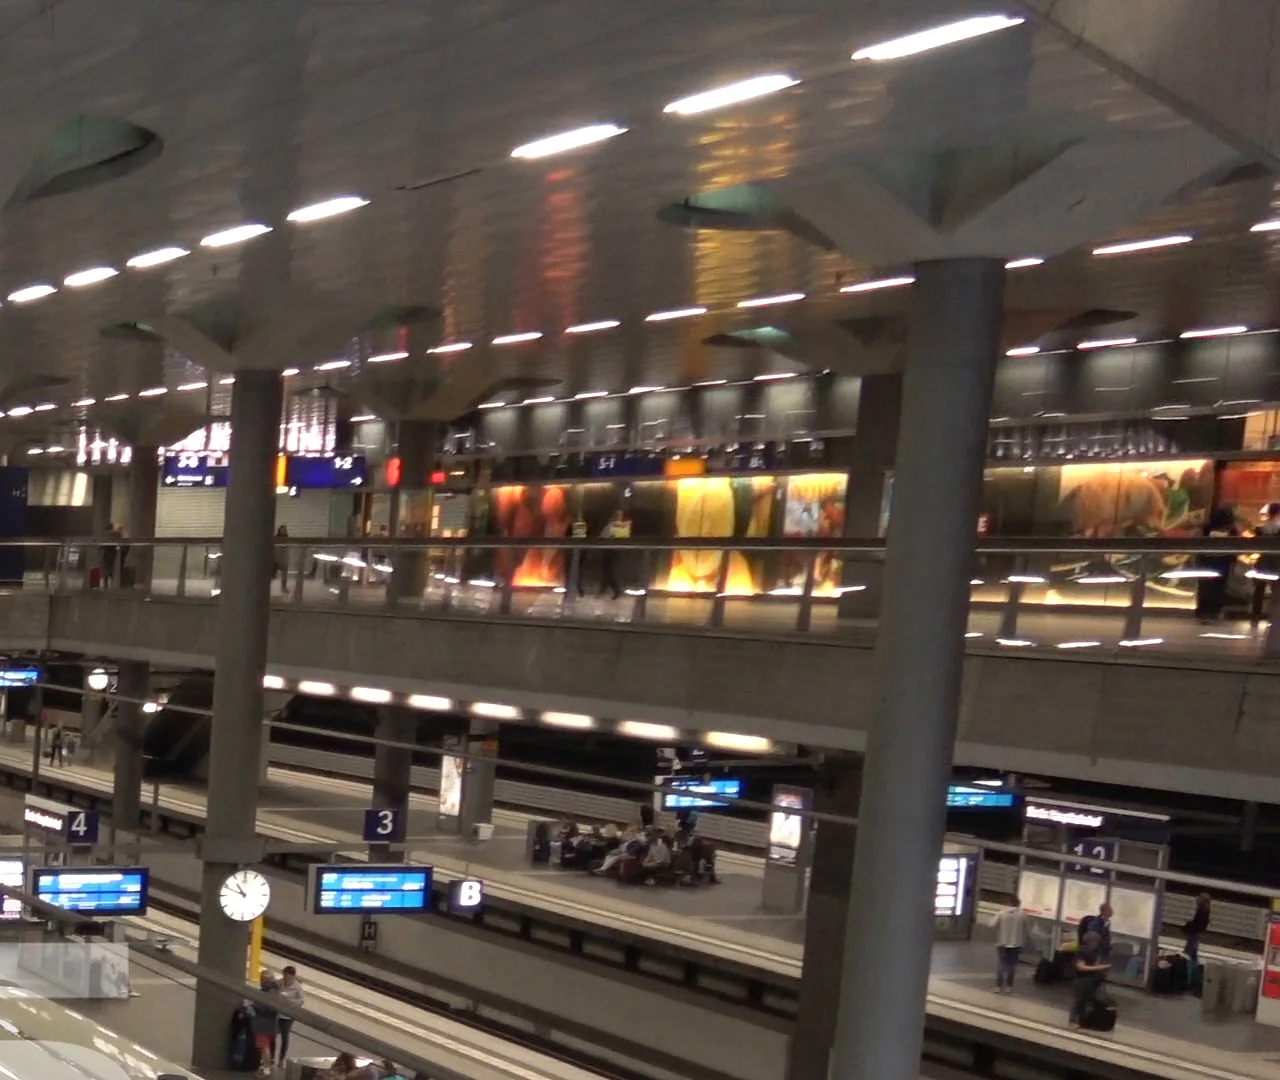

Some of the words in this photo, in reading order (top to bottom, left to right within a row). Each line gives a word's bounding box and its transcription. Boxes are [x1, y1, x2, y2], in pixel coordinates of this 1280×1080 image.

[334, 457, 352, 468] 1-2
[70, 812, 87, 836] 4
[376, 811, 394, 834] 3
[1090, 846, 1105, 873] 2
[460, 881, 481, 906] B
[364, 924, 375, 938] H
